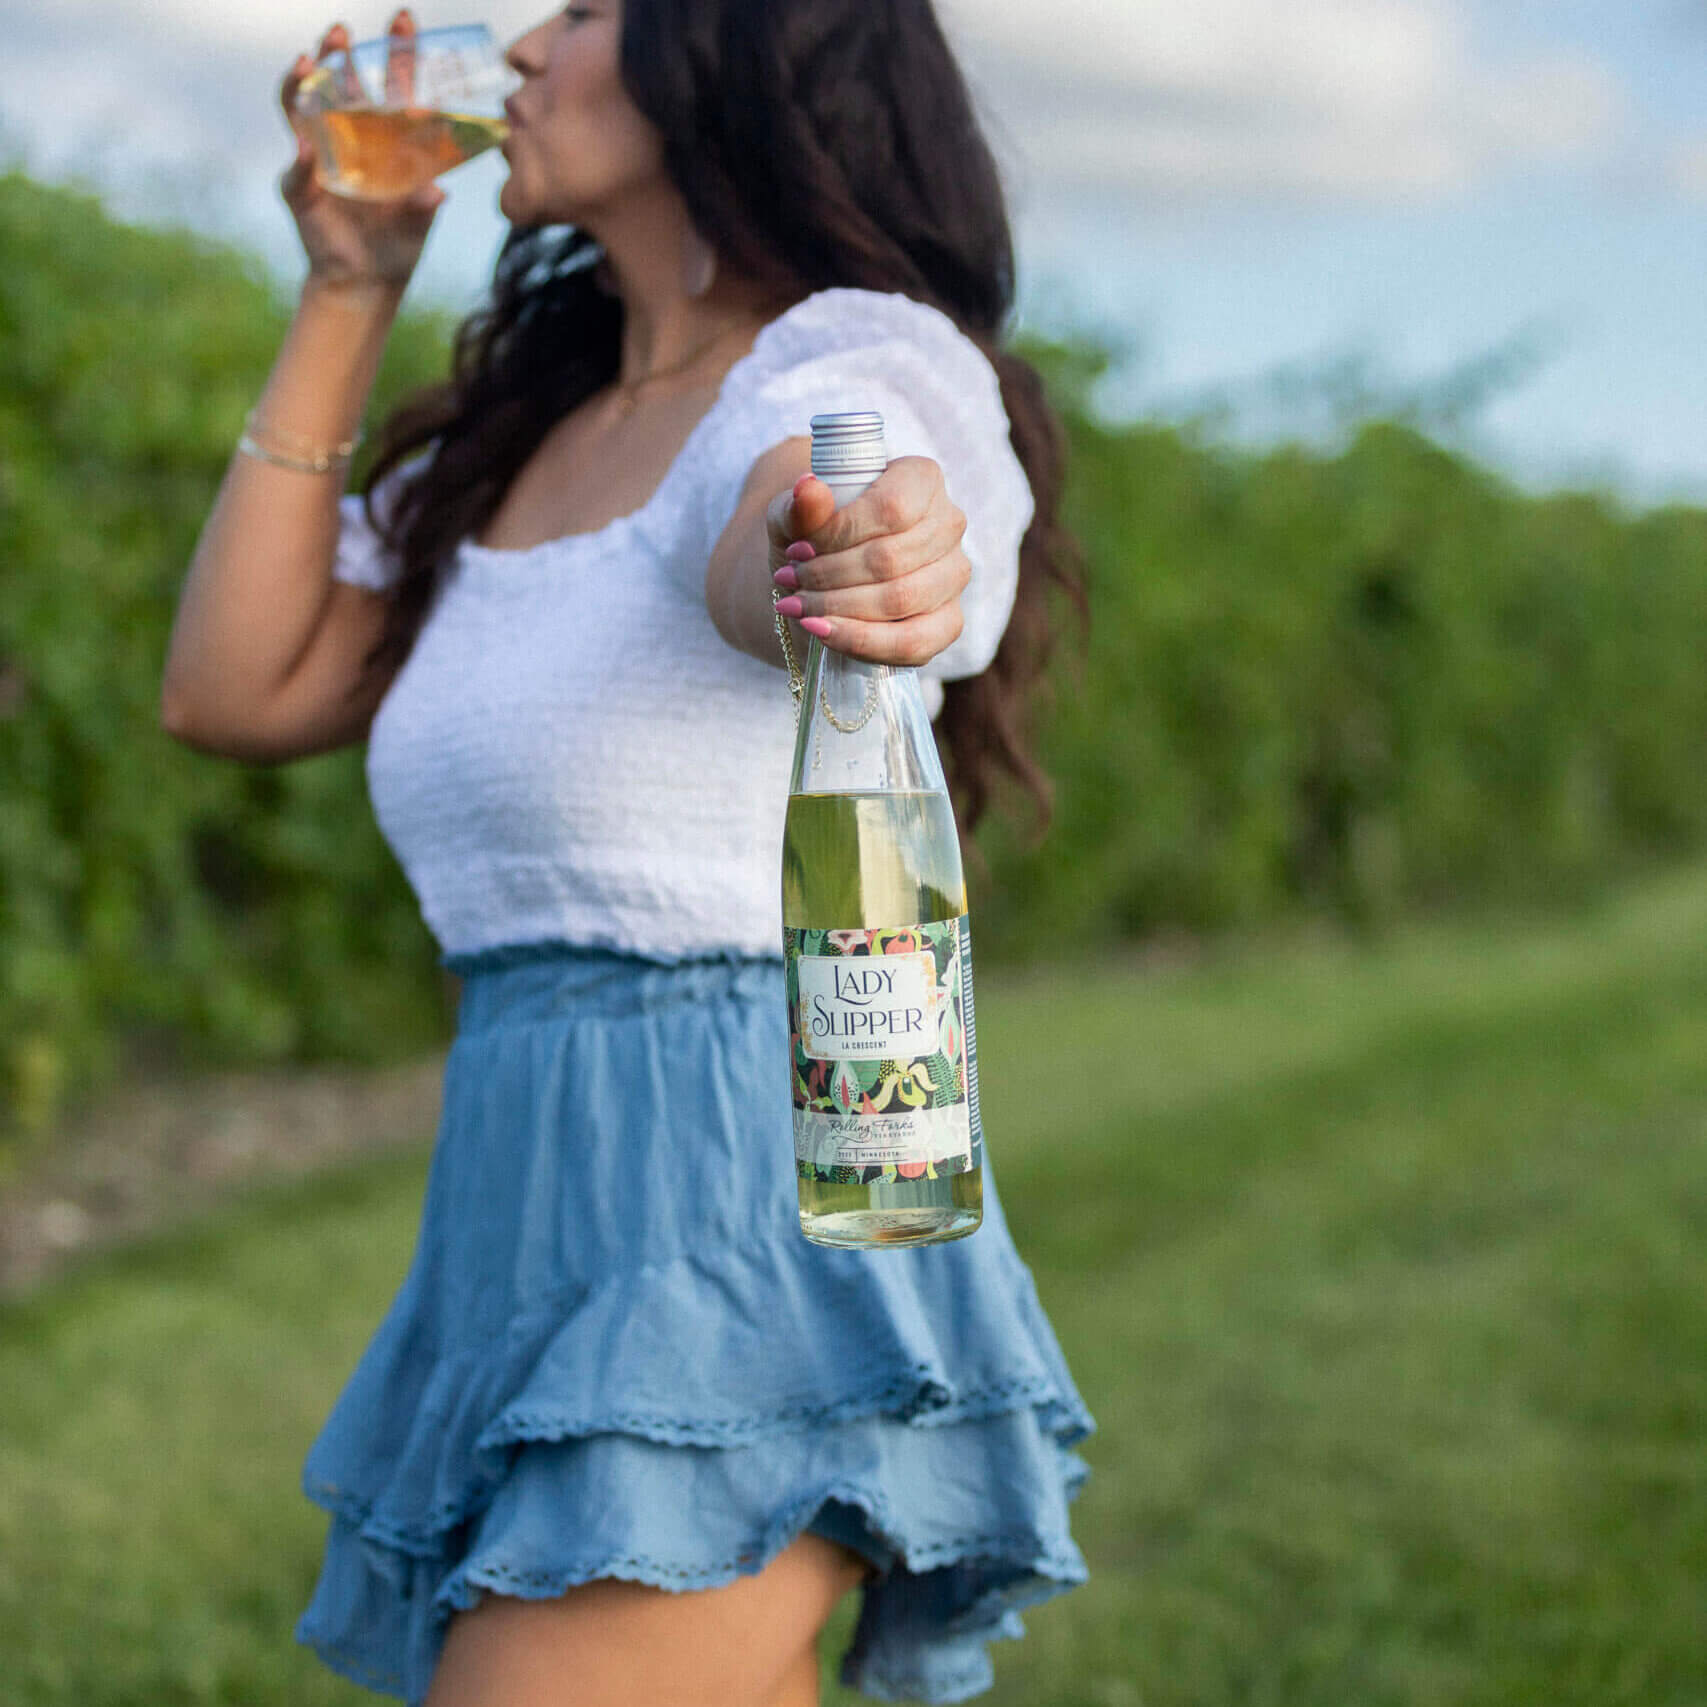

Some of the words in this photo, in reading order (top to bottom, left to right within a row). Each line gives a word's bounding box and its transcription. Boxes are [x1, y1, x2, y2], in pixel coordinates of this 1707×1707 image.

[834, 965, 896, 1005] LADY
[812, 994, 922, 1037] SLIPPER
[841, 1041, 849, 1050] LA
[852, 1040, 887, 1049] CRESCENT
